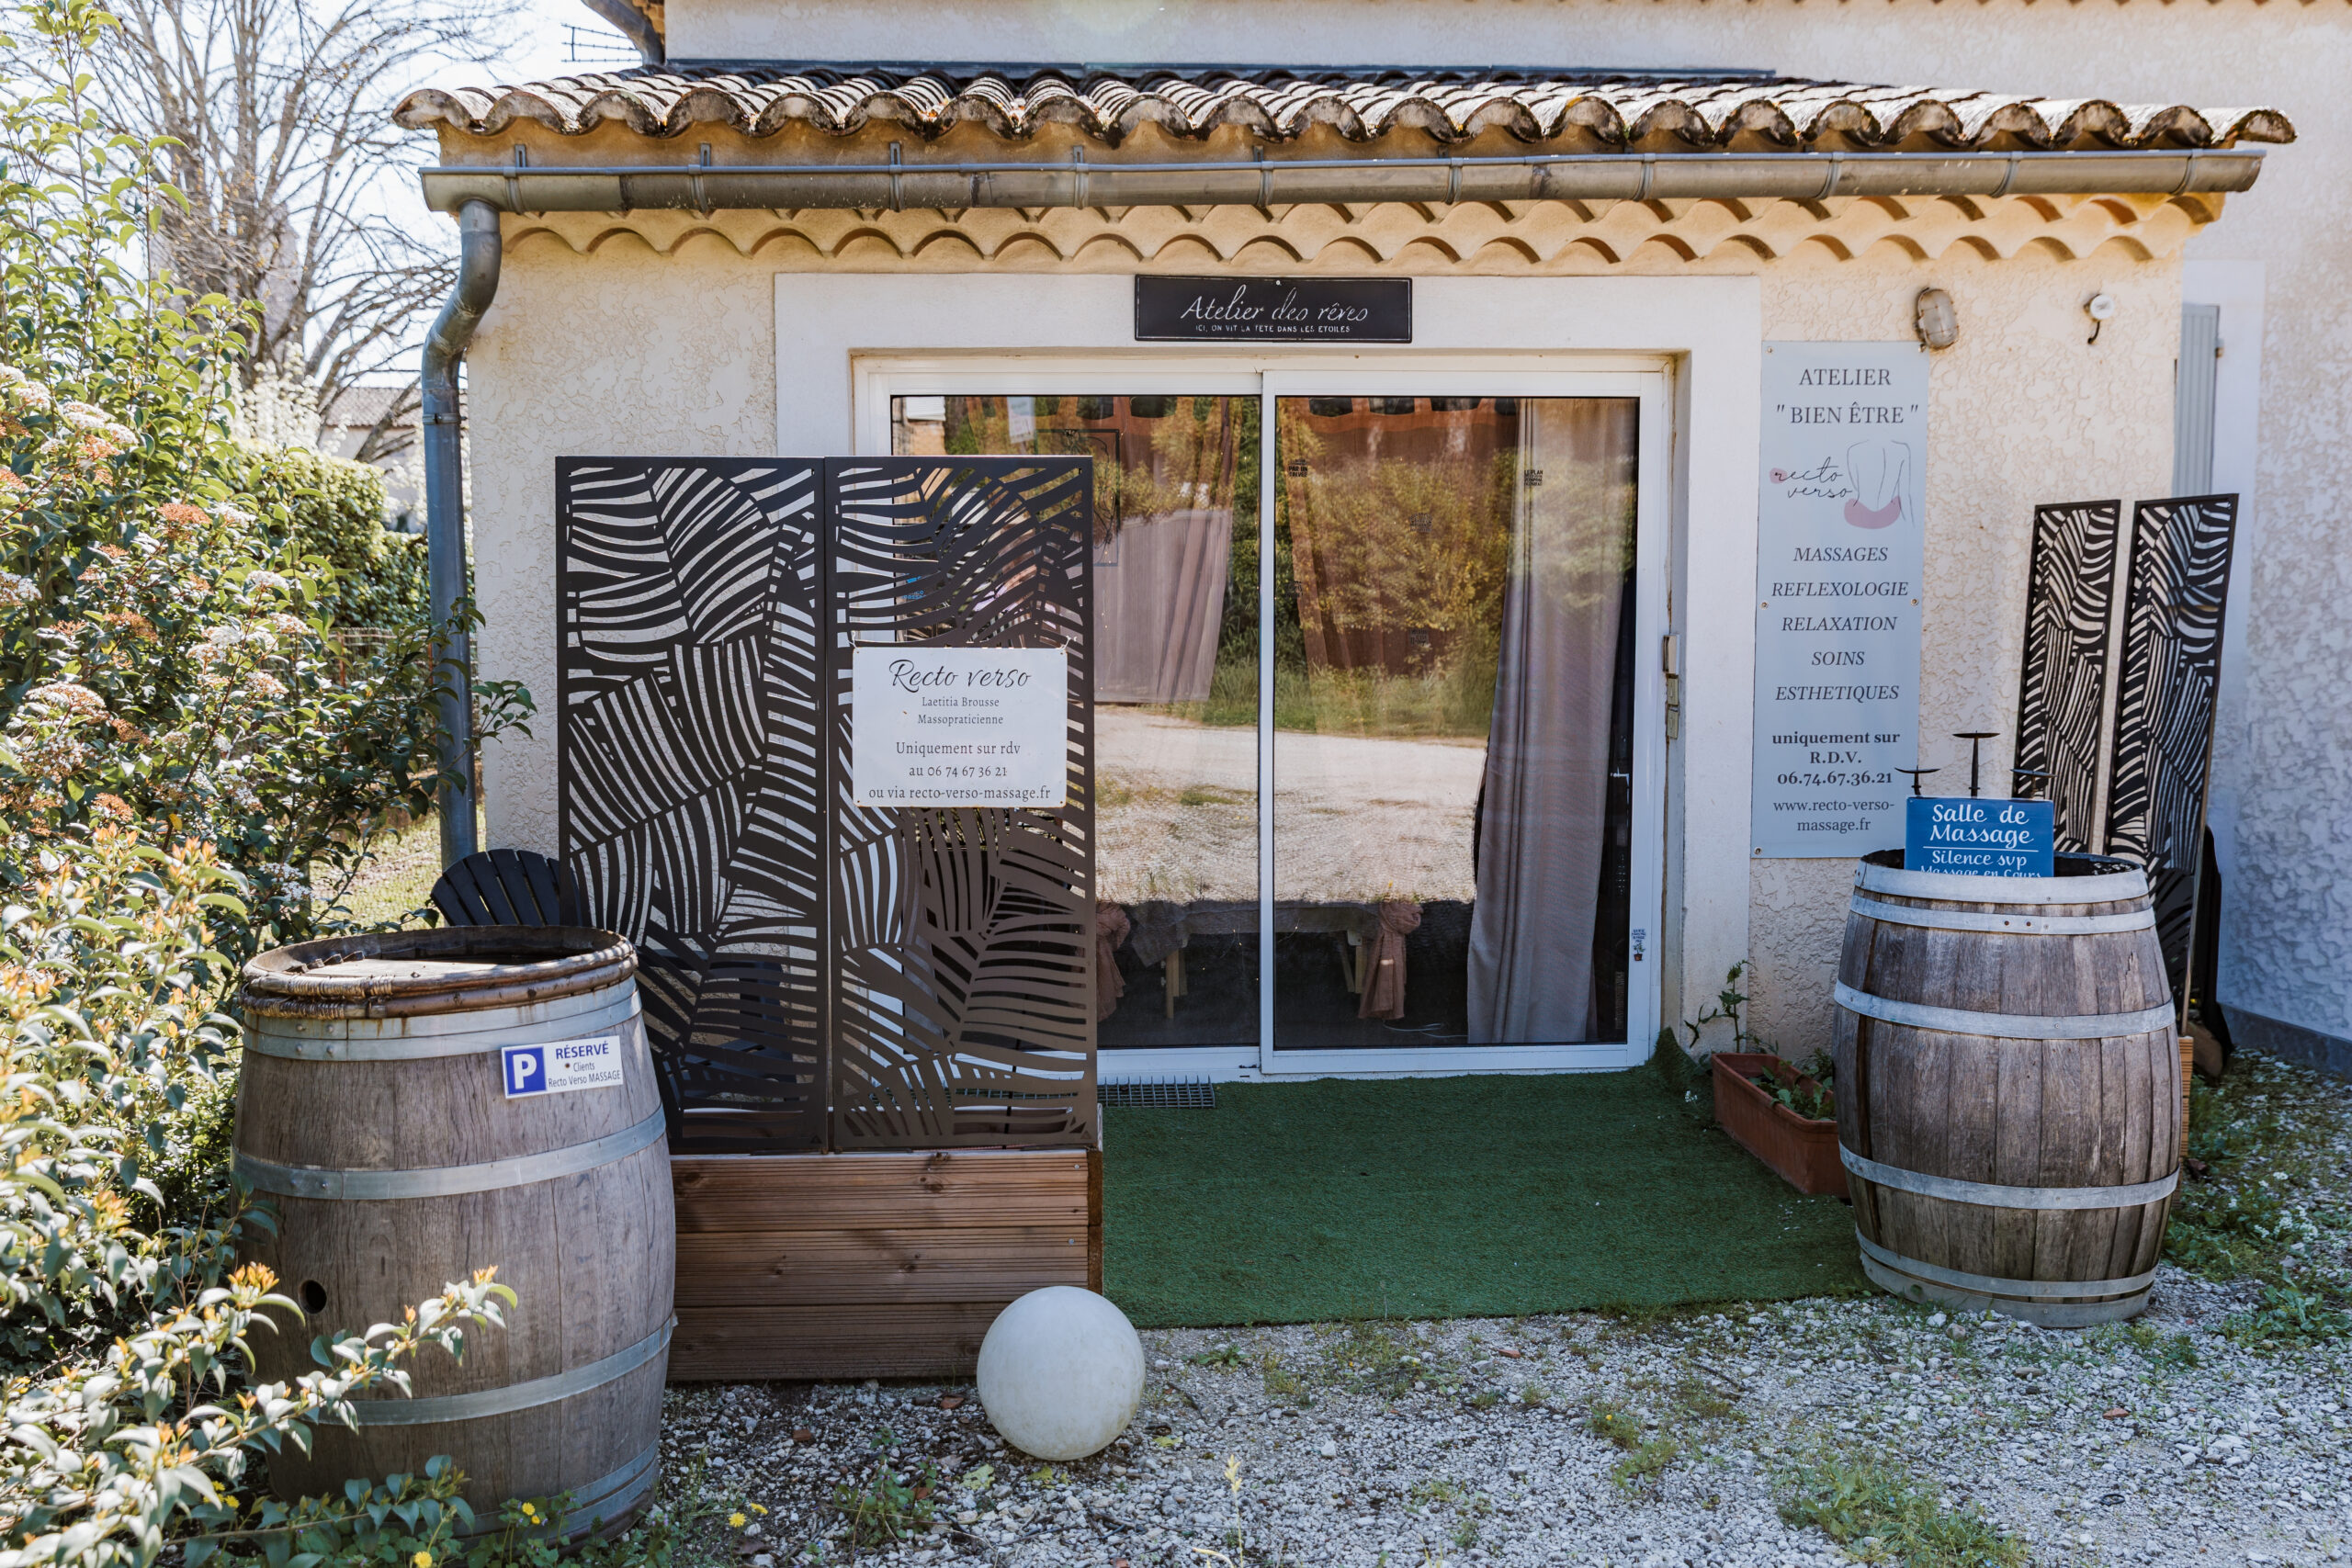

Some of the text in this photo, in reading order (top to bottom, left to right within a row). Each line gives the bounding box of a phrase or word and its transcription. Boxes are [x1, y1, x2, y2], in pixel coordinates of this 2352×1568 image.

[1180, 284, 1369, 321] Atelier des rêves
[1799, 369, 1891, 385] ATELIER
[1791, 407, 1841, 423] BIEN
[1849, 402, 1904, 423] ÊTRE
[1774, 457, 1843, 483] recto
[1788, 486, 1853, 498] verso
[1793, 547, 1888, 561] MASSAGES
[1772, 581, 1908, 596] REFLEXOLOGIE
[1781, 616, 1897, 631] RELAXATION
[1812, 651, 1865, 666] SOINS
[889, 660, 1032, 693] Recto verso
[922, 697, 1000, 706] Laetitia Brousse
[1775, 686, 1899, 703] ESTHETIQUES
[918, 714, 1003, 727] Massopraticienne
[1772, 732, 1900, 747] uniquement sur
[897, 741, 1021, 757] Uniquement sur rdv
[1810, 751, 1862, 763] R.D.V.
[910, 766, 1007, 778] au 06 74 67 36 21
[1778, 771, 1893, 786] 06.74.67.36.21
[869, 785, 1051, 802] ou via recto-verso-massage.fr
[1773, 800, 1894, 811] www.recto-verso-
[1932, 804, 2030, 825] Salle de
[1797, 818, 1871, 833] massage.fr
[1930, 824, 2034, 849] Massage
[1932, 850, 2027, 870] Silence svp
[556, 1041, 609, 1059] RÉSERVÉ
[573, 1061, 595, 1072] Clients
[548, 1070, 620, 1088] Recto Verso MASSAGE
